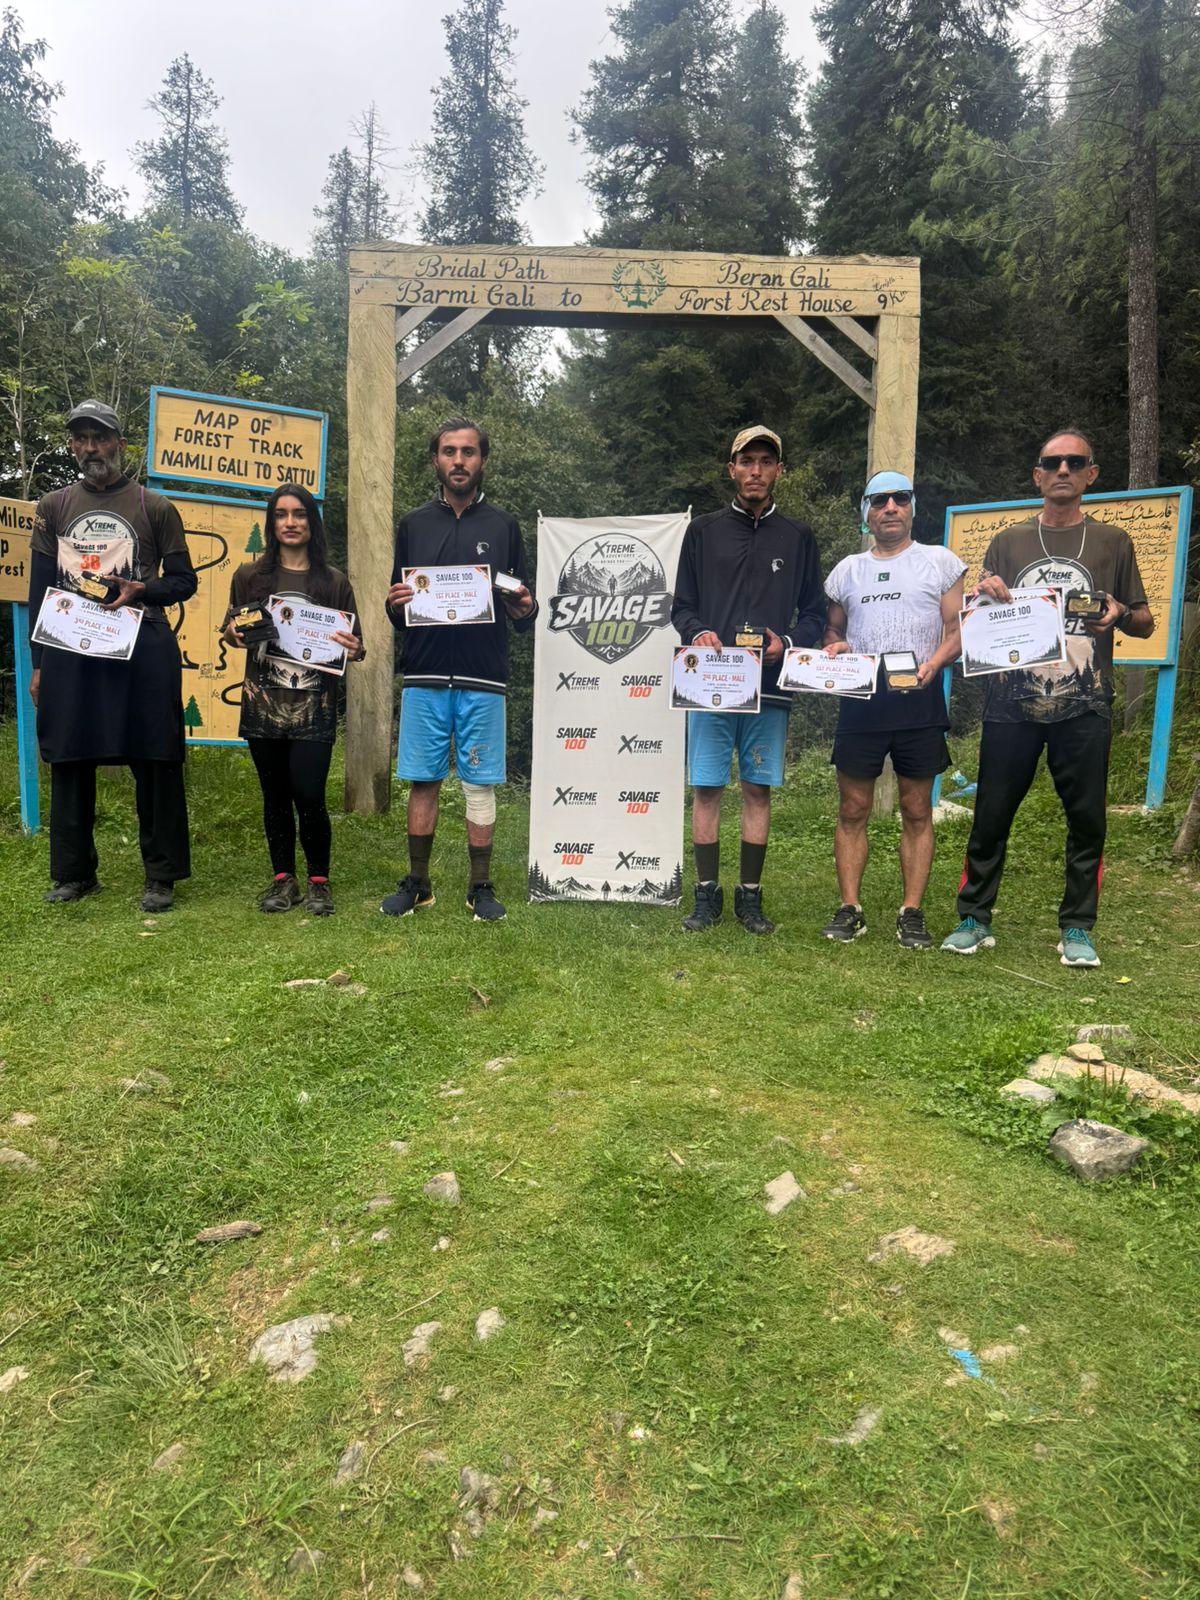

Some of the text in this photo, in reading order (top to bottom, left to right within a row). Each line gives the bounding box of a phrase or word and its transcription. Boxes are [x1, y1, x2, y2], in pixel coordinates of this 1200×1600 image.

[415, 254, 487, 280] Bridal
[494, 256, 549, 281] Path
[717, 260, 832, 290] Beran Gali
[396, 279, 478, 306] Barmi
[487, 283, 536, 307] Gali
[558, 287, 582, 307] to
[674, 288, 857, 313] Forst Rest House
[877, 293, 888, 310] 9
[193, 408, 272, 436] MAP OF
[174, 427, 303, 460] FOREST TRACK
[160, 449, 315, 487] NAMLI GALI TO SATTU
[0, 506, 33, 531] Miles
[83, 518, 117, 533] XTREME
[591, 540, 636, 559] XTREME
[80, 554, 101, 570] 38
[436, 573, 460, 582] SAVAGE
[1035, 568, 1074, 584] XTREME
[860, 592, 902, 604] GYRO
[81, 602, 109, 615] SAVAGE
[300, 609, 323, 622] SAVAGE
[324, 614, 336, 624] 100
[552, 594, 667, 629] SAVAGE
[988, 605, 1031, 621] SAVAGE 100
[585, 620, 637, 646] 100
[706, 654, 744, 664] SAVAGE 100
[555, 671, 600, 692] XTREME
[621, 675, 663, 687] SAVAGE
[732, 674, 746, 682] MALE
[628, 686, 652, 698] 100
[556, 727, 598, 739] SAVAGE
[564, 738, 588, 750] 100
[617, 734, 663, 755] XTREME
[552, 786, 598, 807] XTREME
[618, 791, 661, 803] SAVAGE
[626, 802, 650, 814] 100
[553, 842, 595, 854] SAVAGE
[560, 854, 584, 866] 100
[614, 850, 661, 871] XTREME
